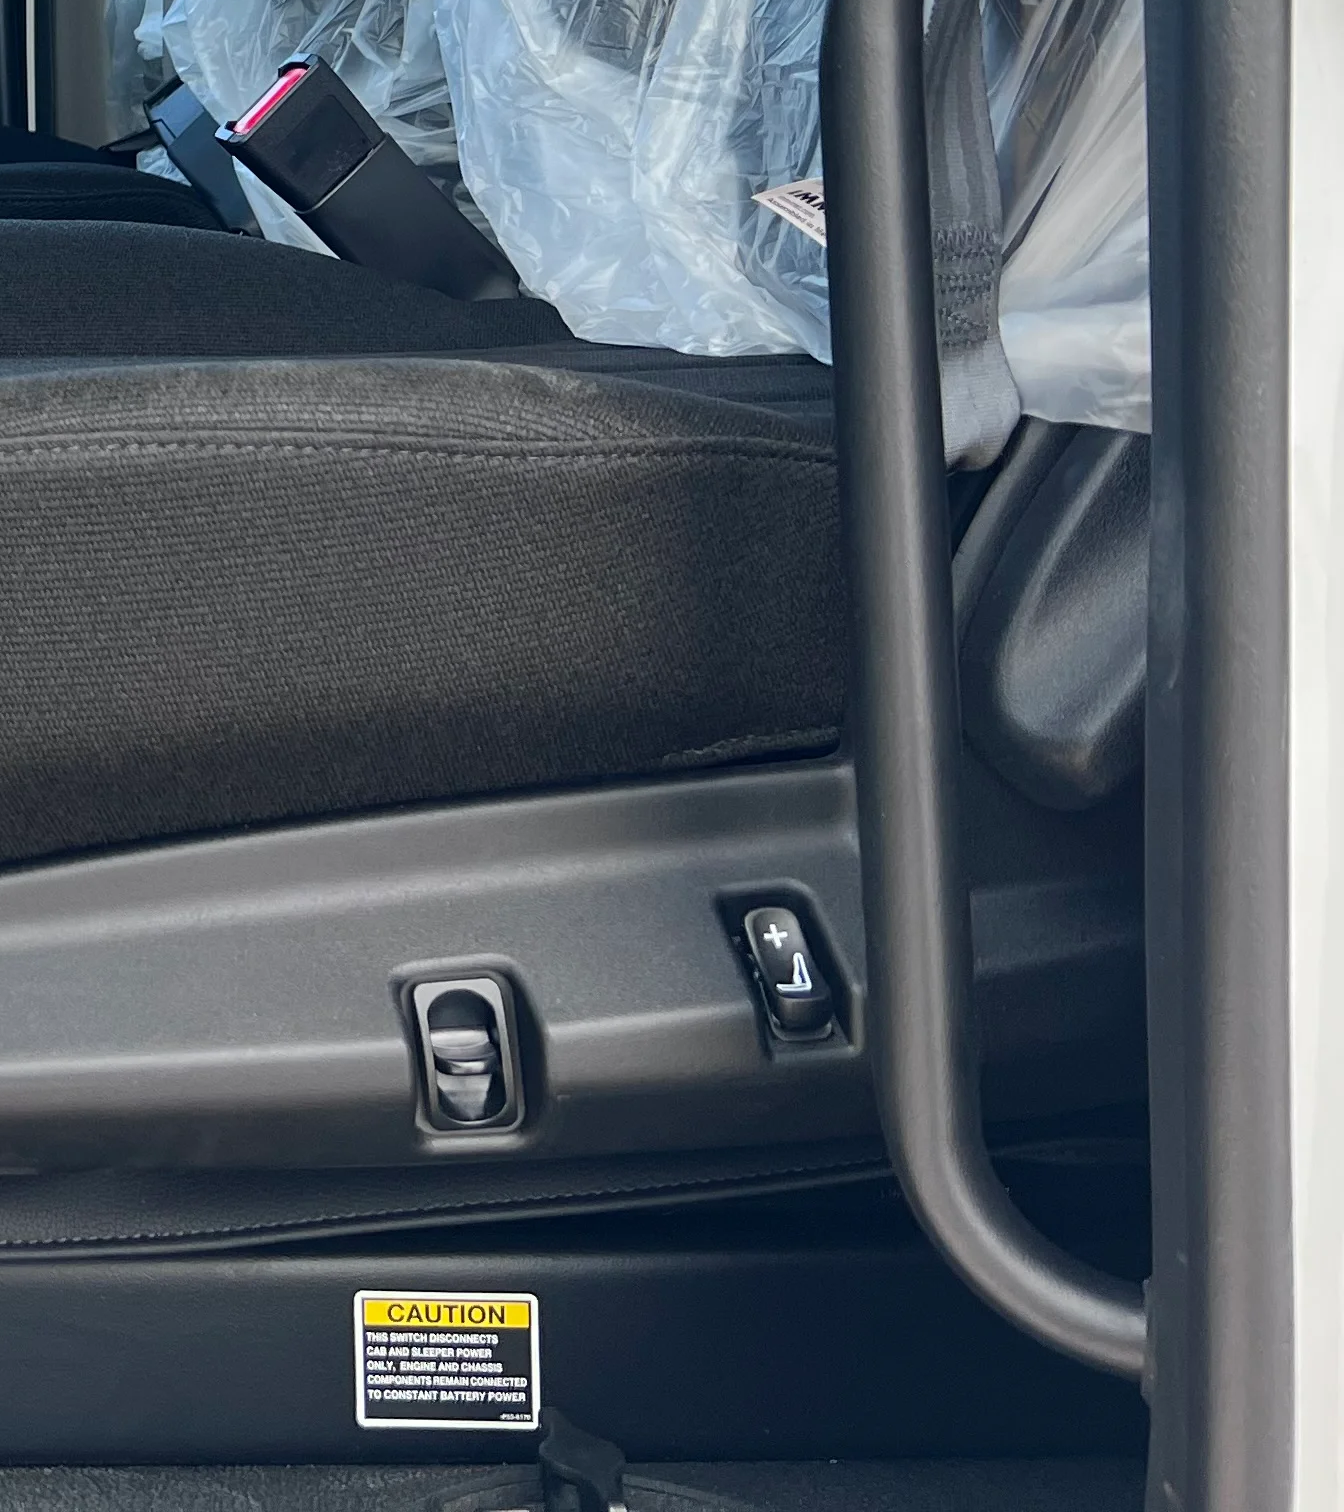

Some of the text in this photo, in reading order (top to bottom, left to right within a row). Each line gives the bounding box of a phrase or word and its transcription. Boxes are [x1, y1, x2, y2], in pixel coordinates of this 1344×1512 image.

[387, 1303, 505, 1324] CAUTION
[365, 1331, 499, 1344] THIS SWITCH DISCONNECTS
[366, 1345, 492, 1358] CAB AND SLEEPER POWER
[400, 1360, 437, 1371] ENGINE
[438, 1361, 459, 1372] AND
[460, 1362, 503, 1373] CHASSIS
[367, 1374, 528, 1387] COMPONENTS REMAIN CONNECTED
[367, 1389, 526, 1402] TO CONSTANT BATTERY POWER
